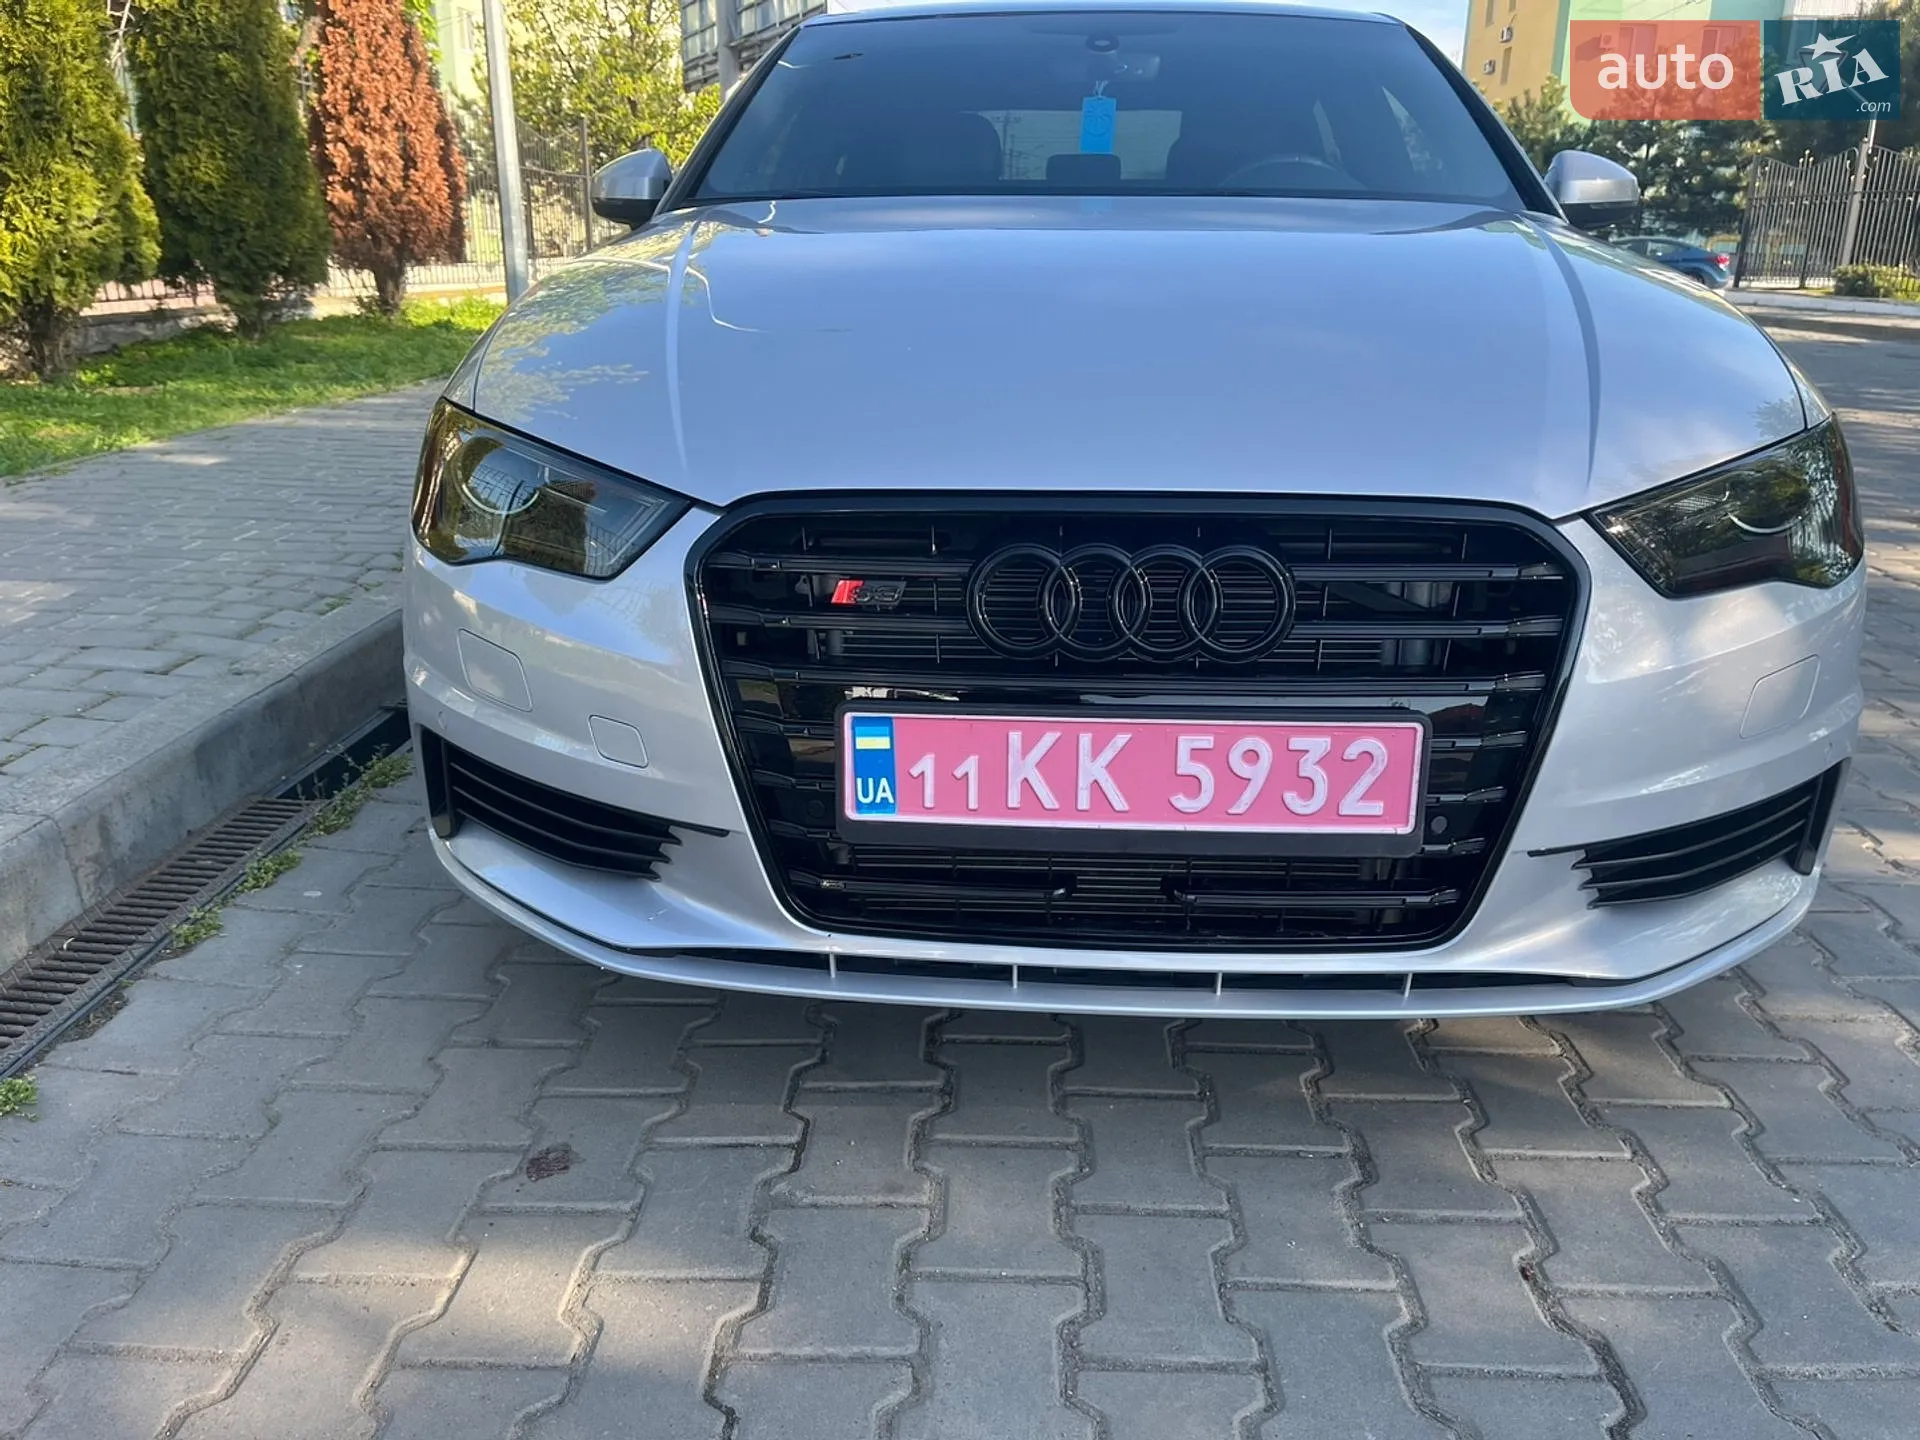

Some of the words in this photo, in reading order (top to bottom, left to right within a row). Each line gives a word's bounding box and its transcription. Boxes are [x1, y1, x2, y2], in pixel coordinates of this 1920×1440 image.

[856, 777, 895, 804] UA
[908, 753, 979, 810] 11
[1006, 730, 1132, 812] KK
[1169, 735, 1389, 816] 5932
